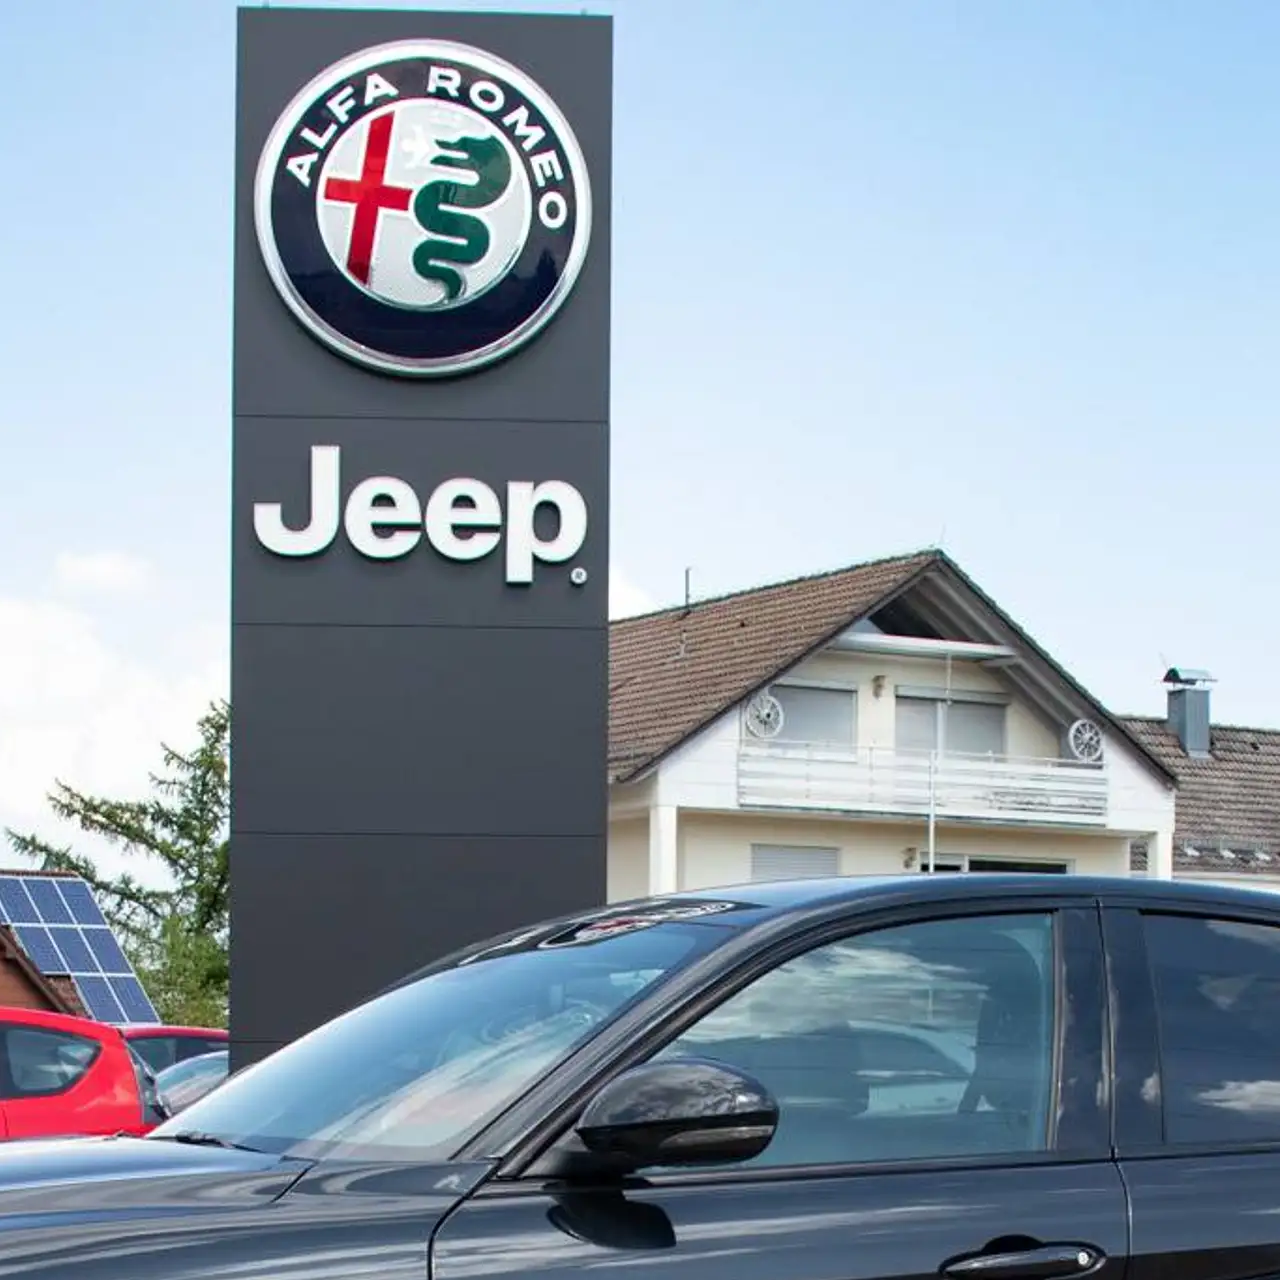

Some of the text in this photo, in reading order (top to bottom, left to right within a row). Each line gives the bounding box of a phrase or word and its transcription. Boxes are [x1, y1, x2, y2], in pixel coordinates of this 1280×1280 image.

[286, 65, 568, 229] ALFA ROMEO
[253, 445, 587, 583] Jeep
